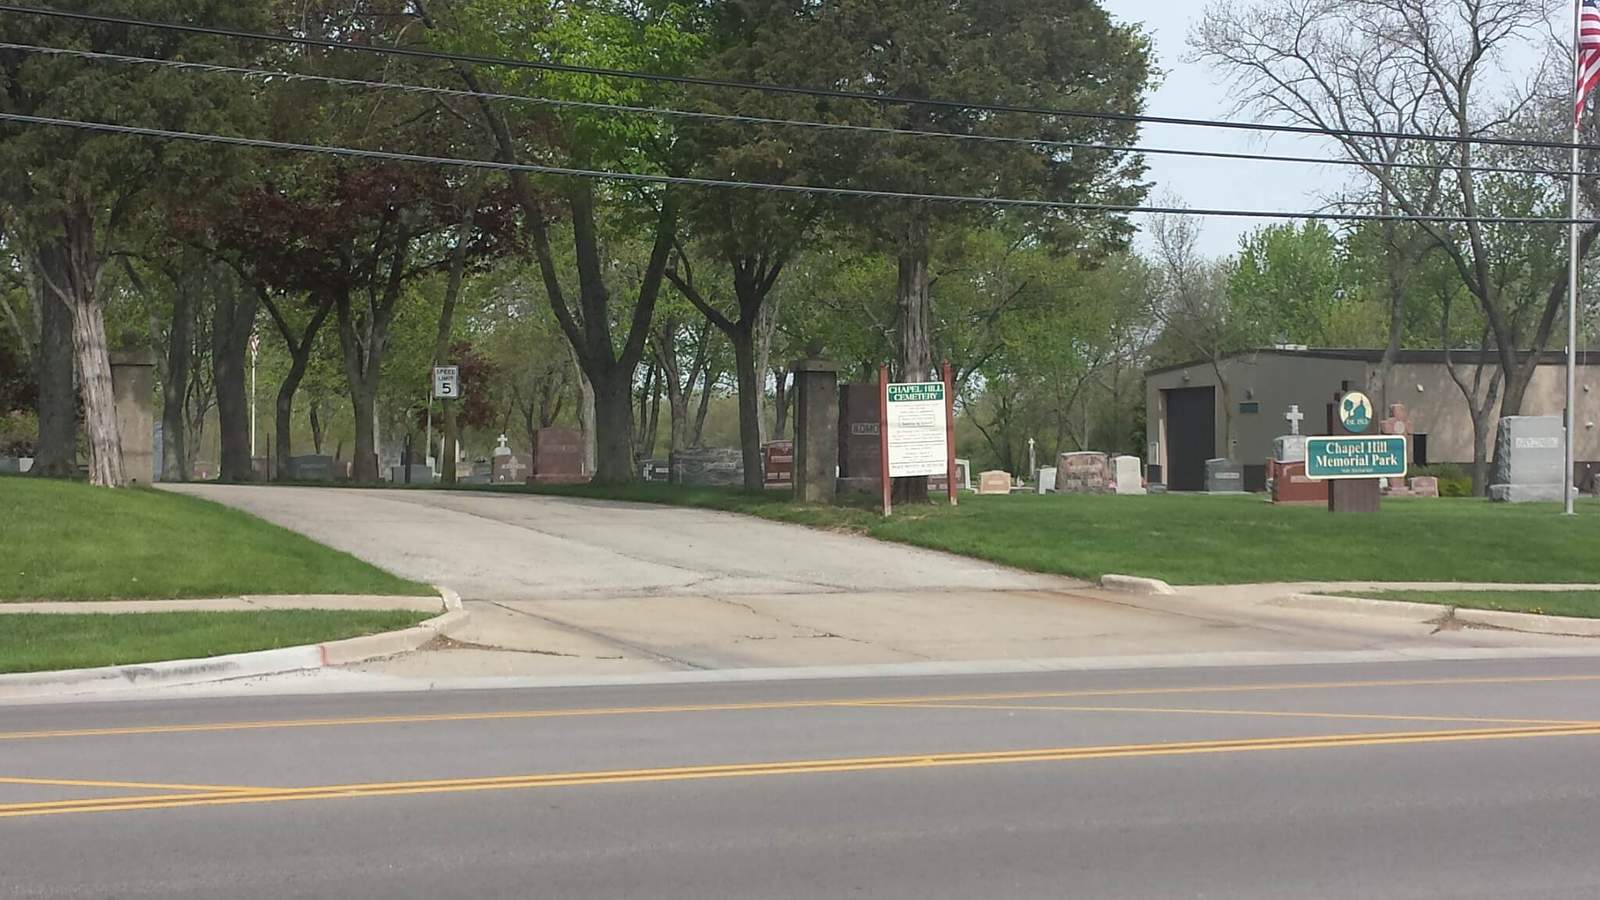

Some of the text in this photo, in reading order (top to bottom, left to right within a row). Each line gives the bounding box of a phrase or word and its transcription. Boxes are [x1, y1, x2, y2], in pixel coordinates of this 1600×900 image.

[442, 383, 451, 394] 5
[889, 384, 943, 394] CHAPEL HILL
[894, 393, 936, 401] CEMETERY
[1326, 441, 1388, 457] Chapel Hill
[1316, 454, 1398, 468] Memorial Park
